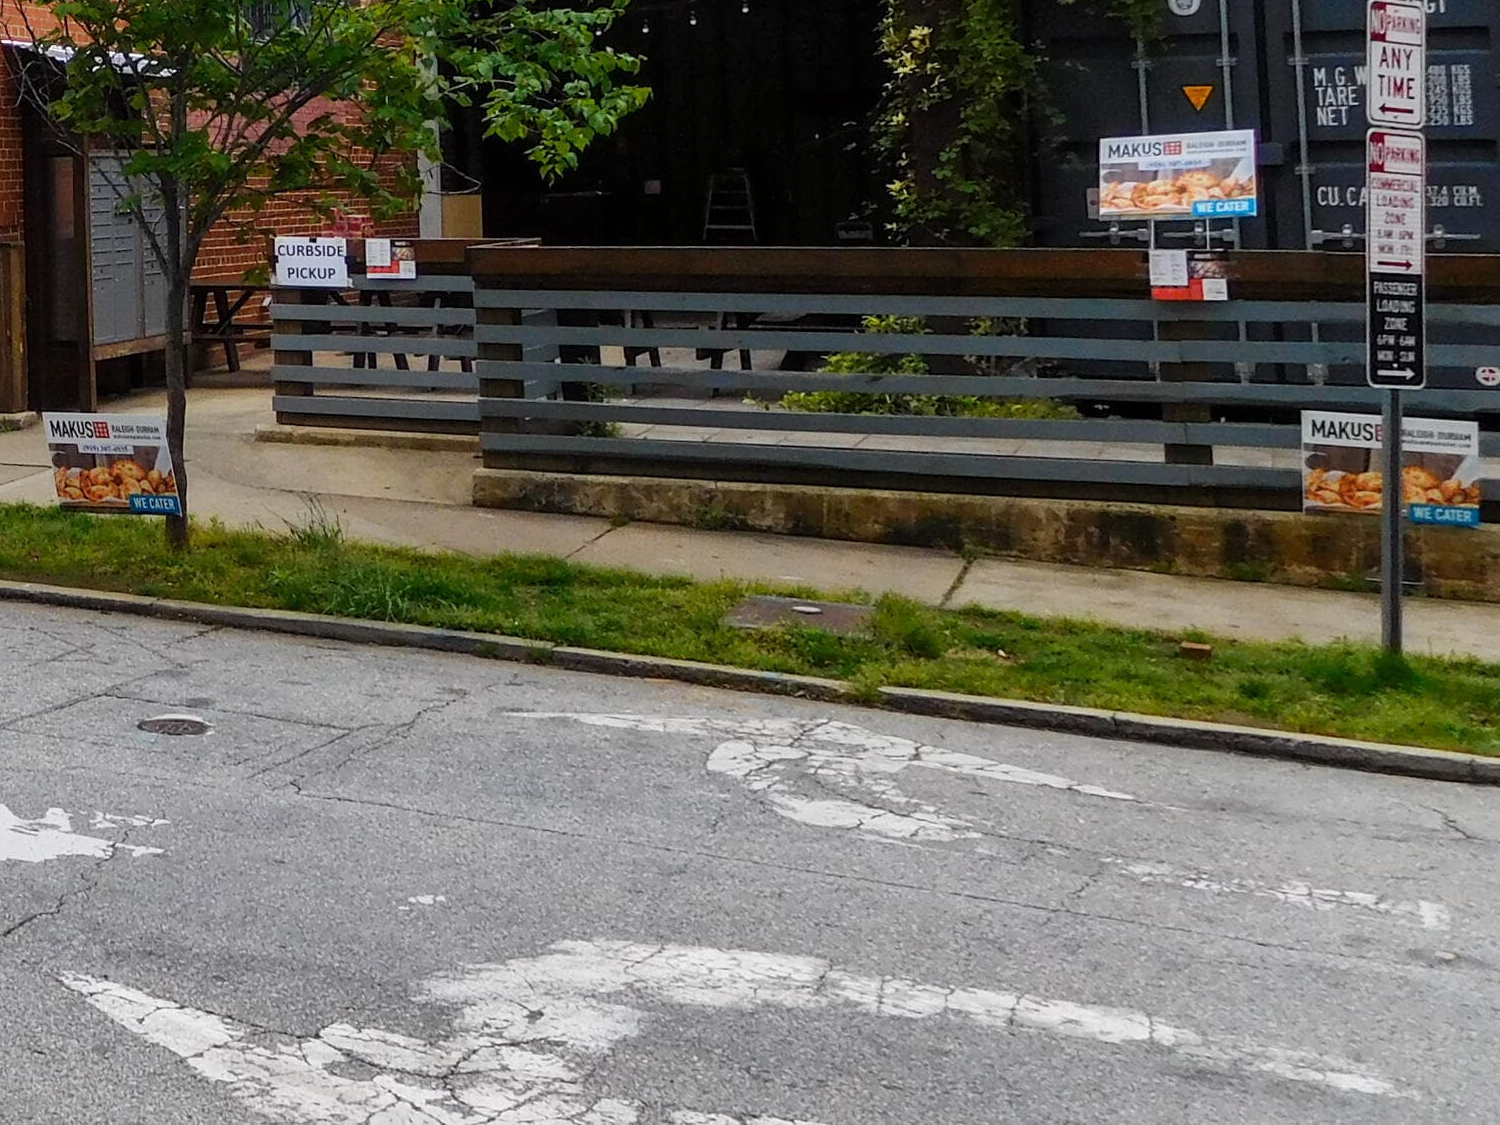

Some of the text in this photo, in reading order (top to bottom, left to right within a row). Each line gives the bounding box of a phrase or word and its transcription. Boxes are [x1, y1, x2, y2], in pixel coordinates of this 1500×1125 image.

[1371, 8, 1421, 35] NO PARKING
[1379, 46, 1413, 71] ANY
[1378, 74, 1415, 100] TIME
[1314, 86, 1359, 106] TARE
[1316, 106, 1349, 126] NET
[1108, 141, 1162, 158] MAKUS
[1370, 142, 1420, 165] NO PARKING
[1371, 177, 1419, 193] COMMERCIAL
[1197, 200, 1249, 213] WE CATER
[1376, 195, 1414, 209] LOADING
[1384, 212, 1407, 225] ZONE
[277, 244, 344, 256] CURBSIDE
[287, 267, 336, 279] PICKUP
[1373, 281, 1417, 296] PASSENGER
[1376, 299, 1415, 313] LOADING
[1384, 317, 1408, 331] ZONE
[50, 420, 94, 438] MAKUS
[1311, 419, 1374, 441] MAKUS
[133, 497, 175, 510] WE CATER
[1413, 506, 1472, 522] WE CATER
